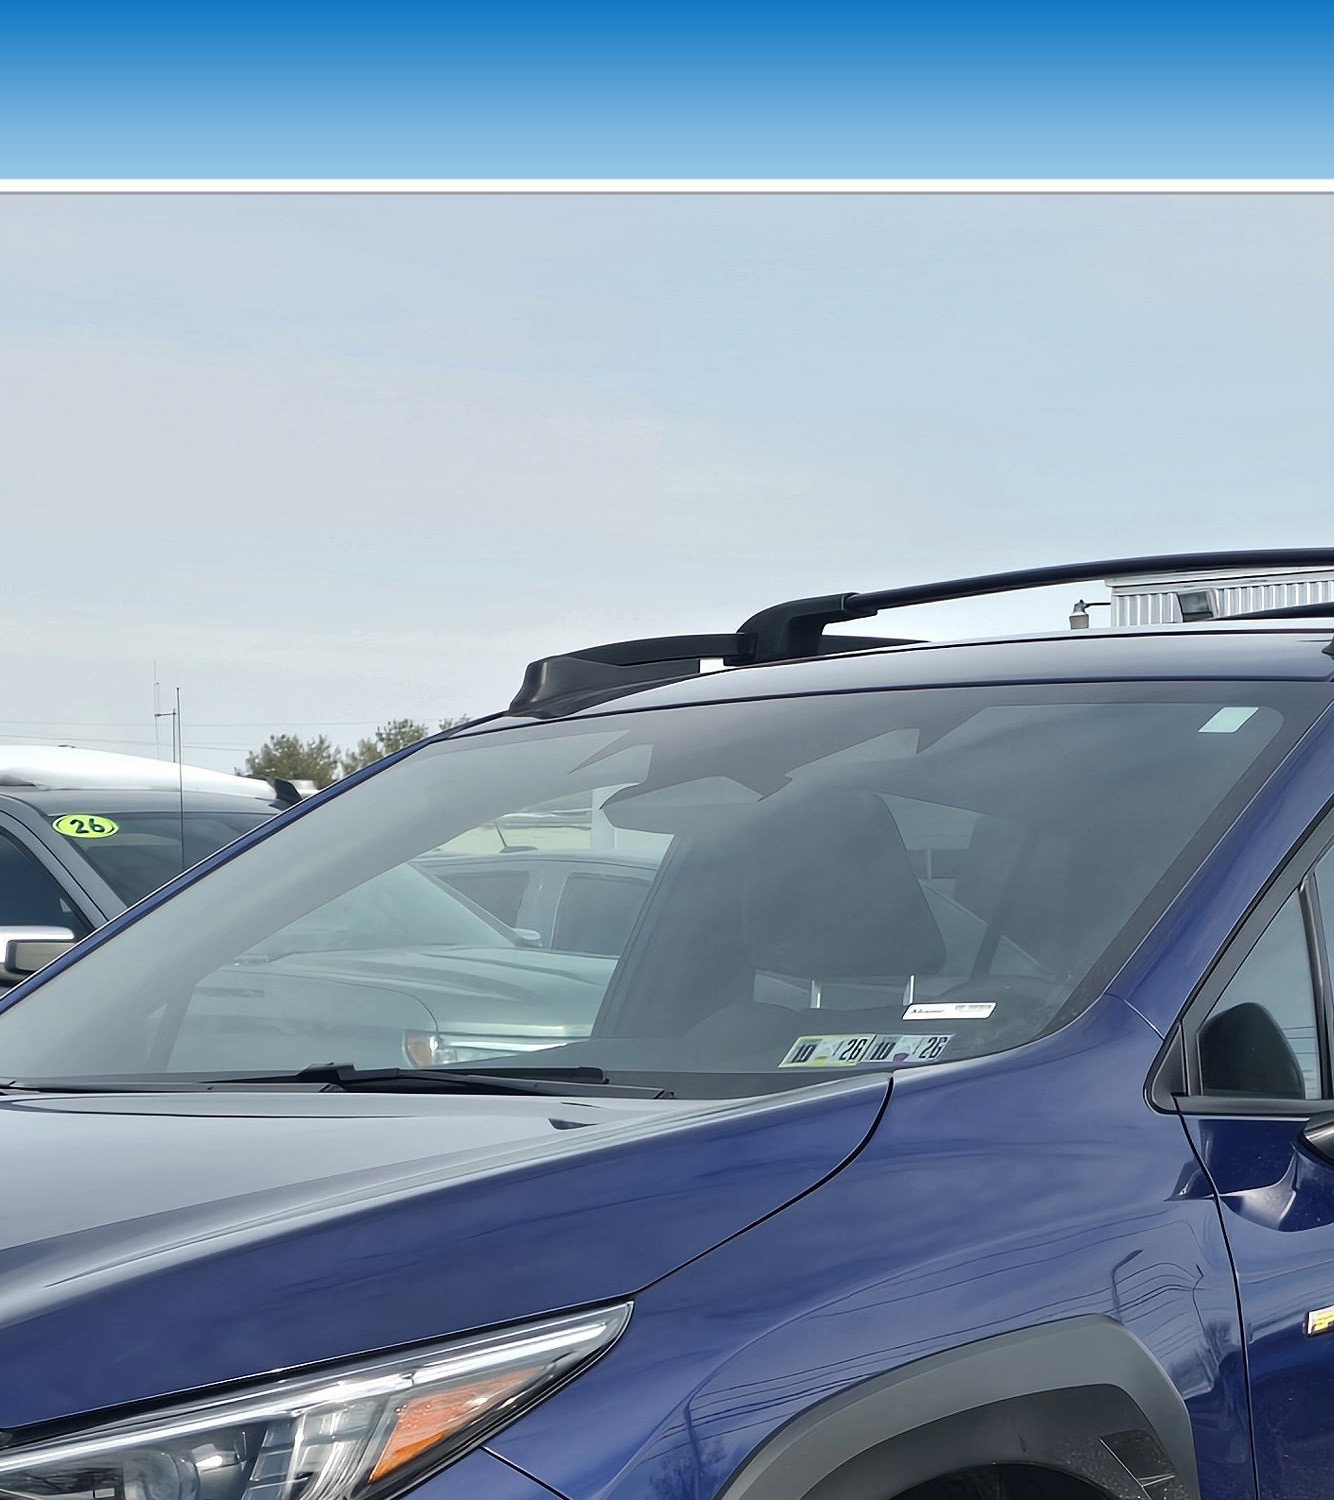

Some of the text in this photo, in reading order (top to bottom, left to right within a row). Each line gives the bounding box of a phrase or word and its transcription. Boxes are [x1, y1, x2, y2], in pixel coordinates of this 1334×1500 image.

[69, 818, 105, 834] 26
[839, 1038, 868, 1061] 26
[919, 1036, 948, 1059] 26
